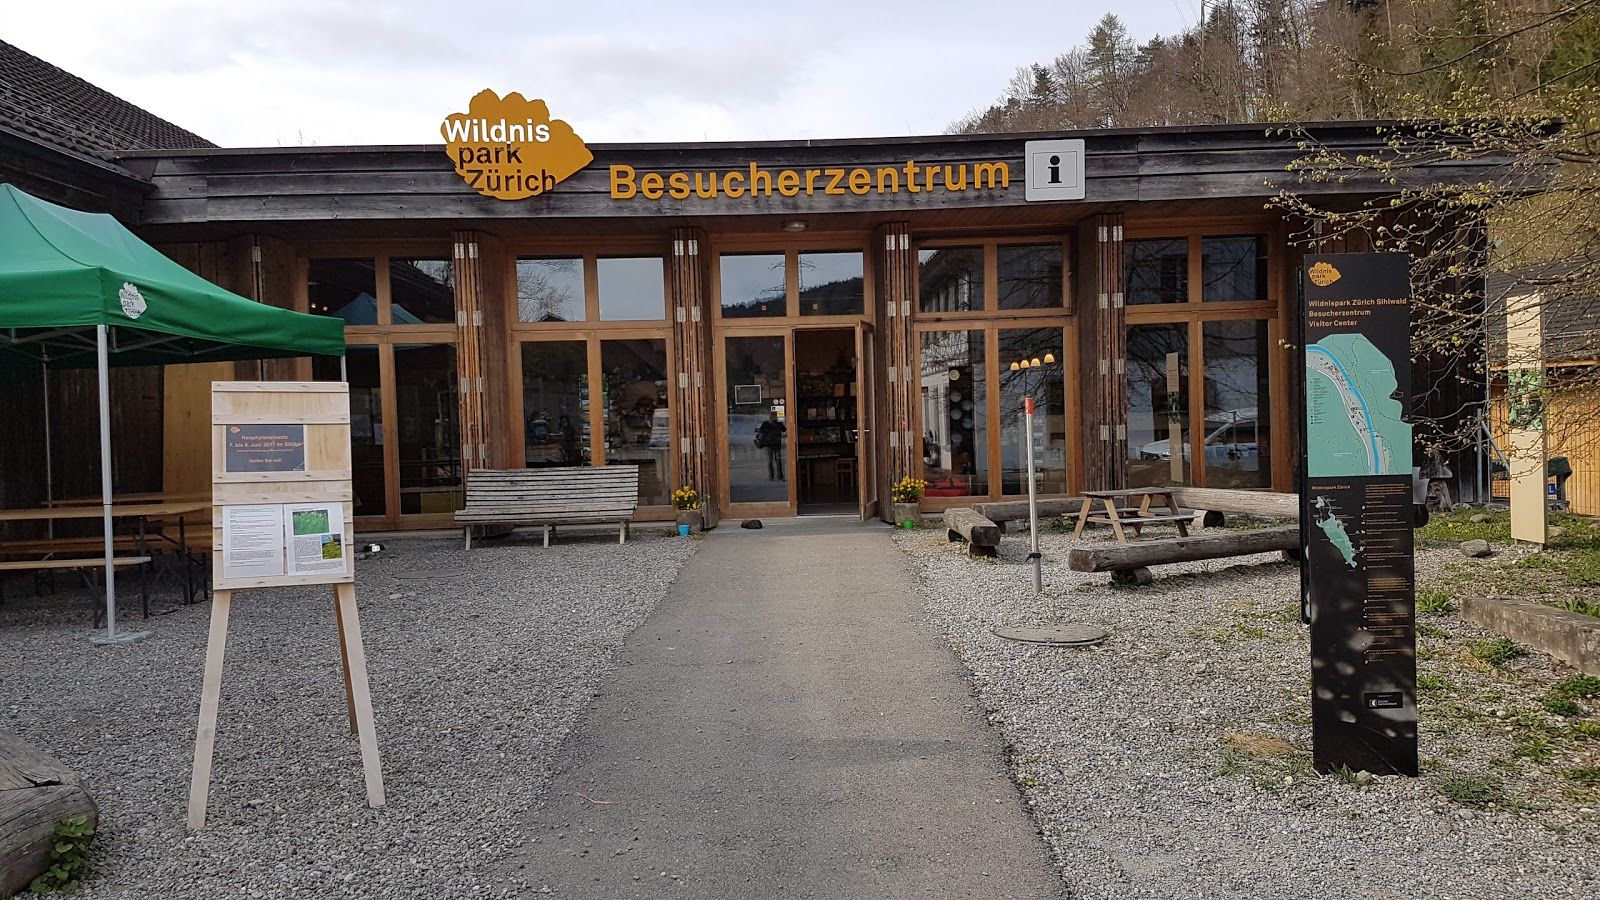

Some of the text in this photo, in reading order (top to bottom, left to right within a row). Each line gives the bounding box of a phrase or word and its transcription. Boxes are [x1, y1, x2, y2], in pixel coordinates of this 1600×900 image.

[445, 118, 550, 143] Wildnis
[458, 142, 523, 170] park
[466, 169, 556, 193] Zürich
[609, 159, 1010, 201] Besucherzentrum
[1047, 155, 1063, 184] i
[1308, 297, 1407, 307] Wildnispark Zürich Sihlwald
[1308, 309, 1371, 317] Besucherzentrum
[1308, 319, 1358, 328] Visitor Center
